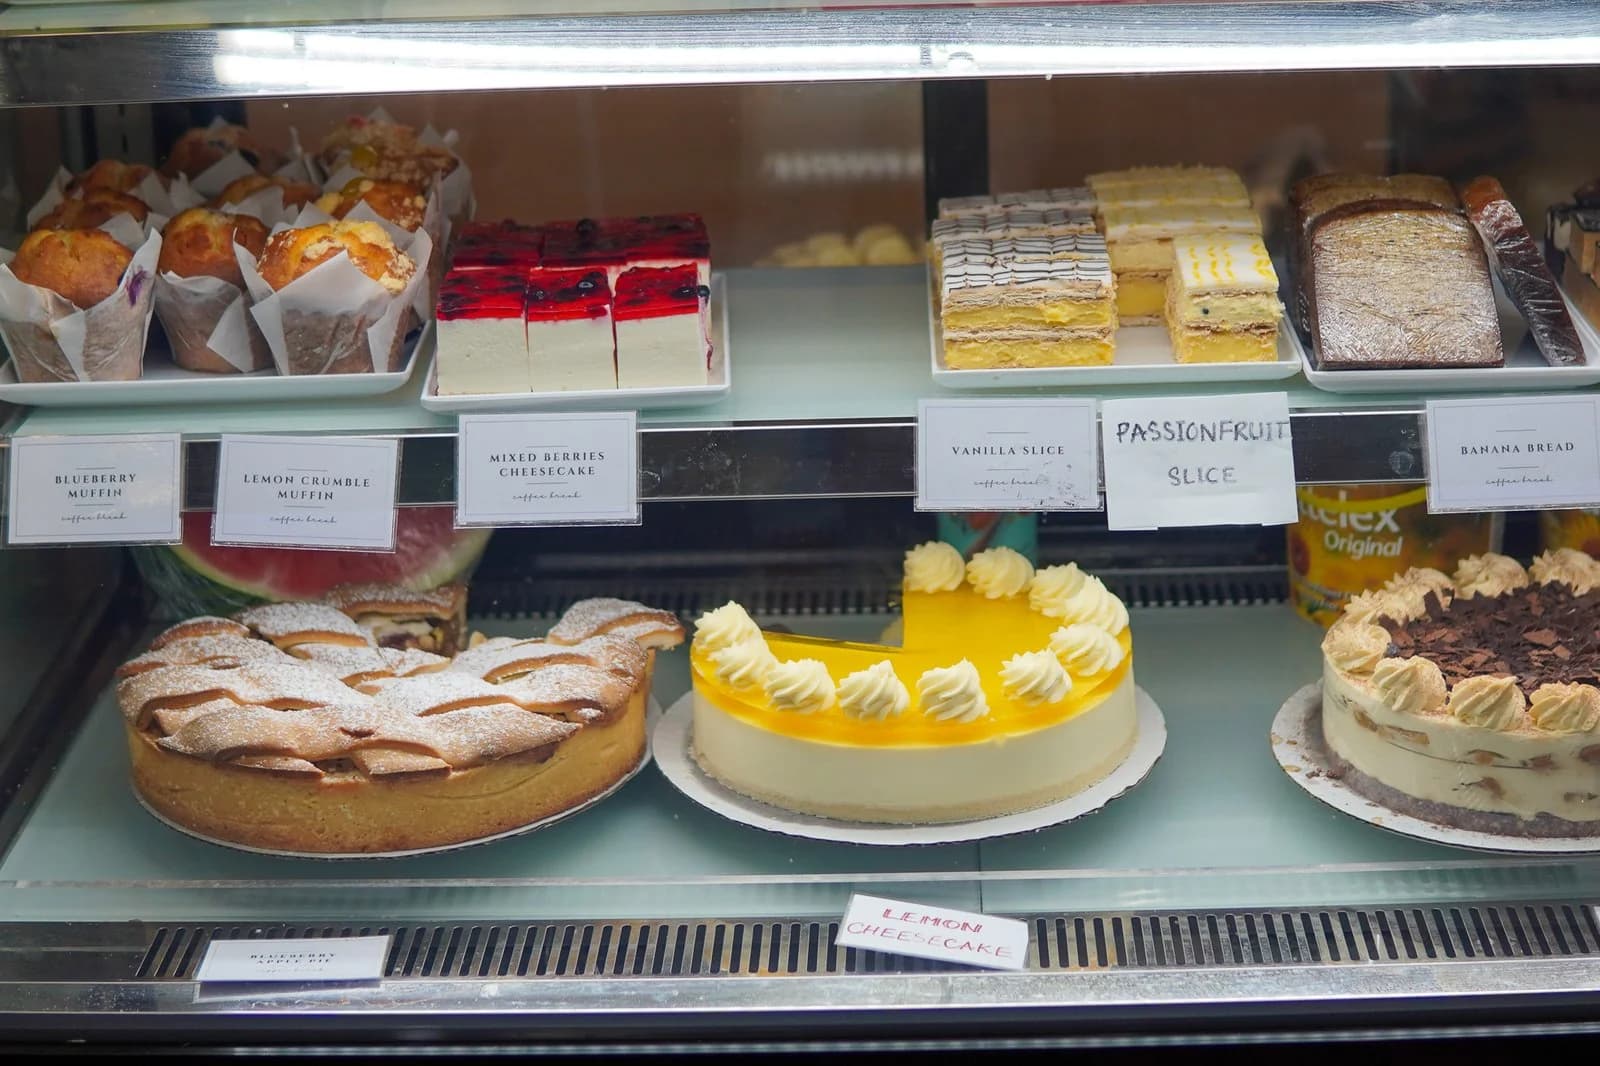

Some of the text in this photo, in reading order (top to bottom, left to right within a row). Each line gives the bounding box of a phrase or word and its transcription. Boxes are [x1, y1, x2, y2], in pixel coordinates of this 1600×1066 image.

[1116, 420, 1289, 443] PASSIONFRUIT
[952, 446, 1064, 455] VANILLA SLICE
[1461, 442, 1574, 455] BANANA BREAD
[490, 451, 605, 463] MIXED BERRIES
[499, 466, 595, 477] CHEESECAKE
[1168, 466, 1237, 486] SLICE
[55, 473, 137, 484] BLUEBERRY
[243, 474, 370, 487] LEMON CRUMBLE
[67, 488, 122, 498] MUFFIN
[277, 490, 333, 500] MUFFIN
[1324, 530, 1403, 560] Original
[882, 908, 983, 934] LEMON
[847, 922, 1013, 958] CHEESECAKE
